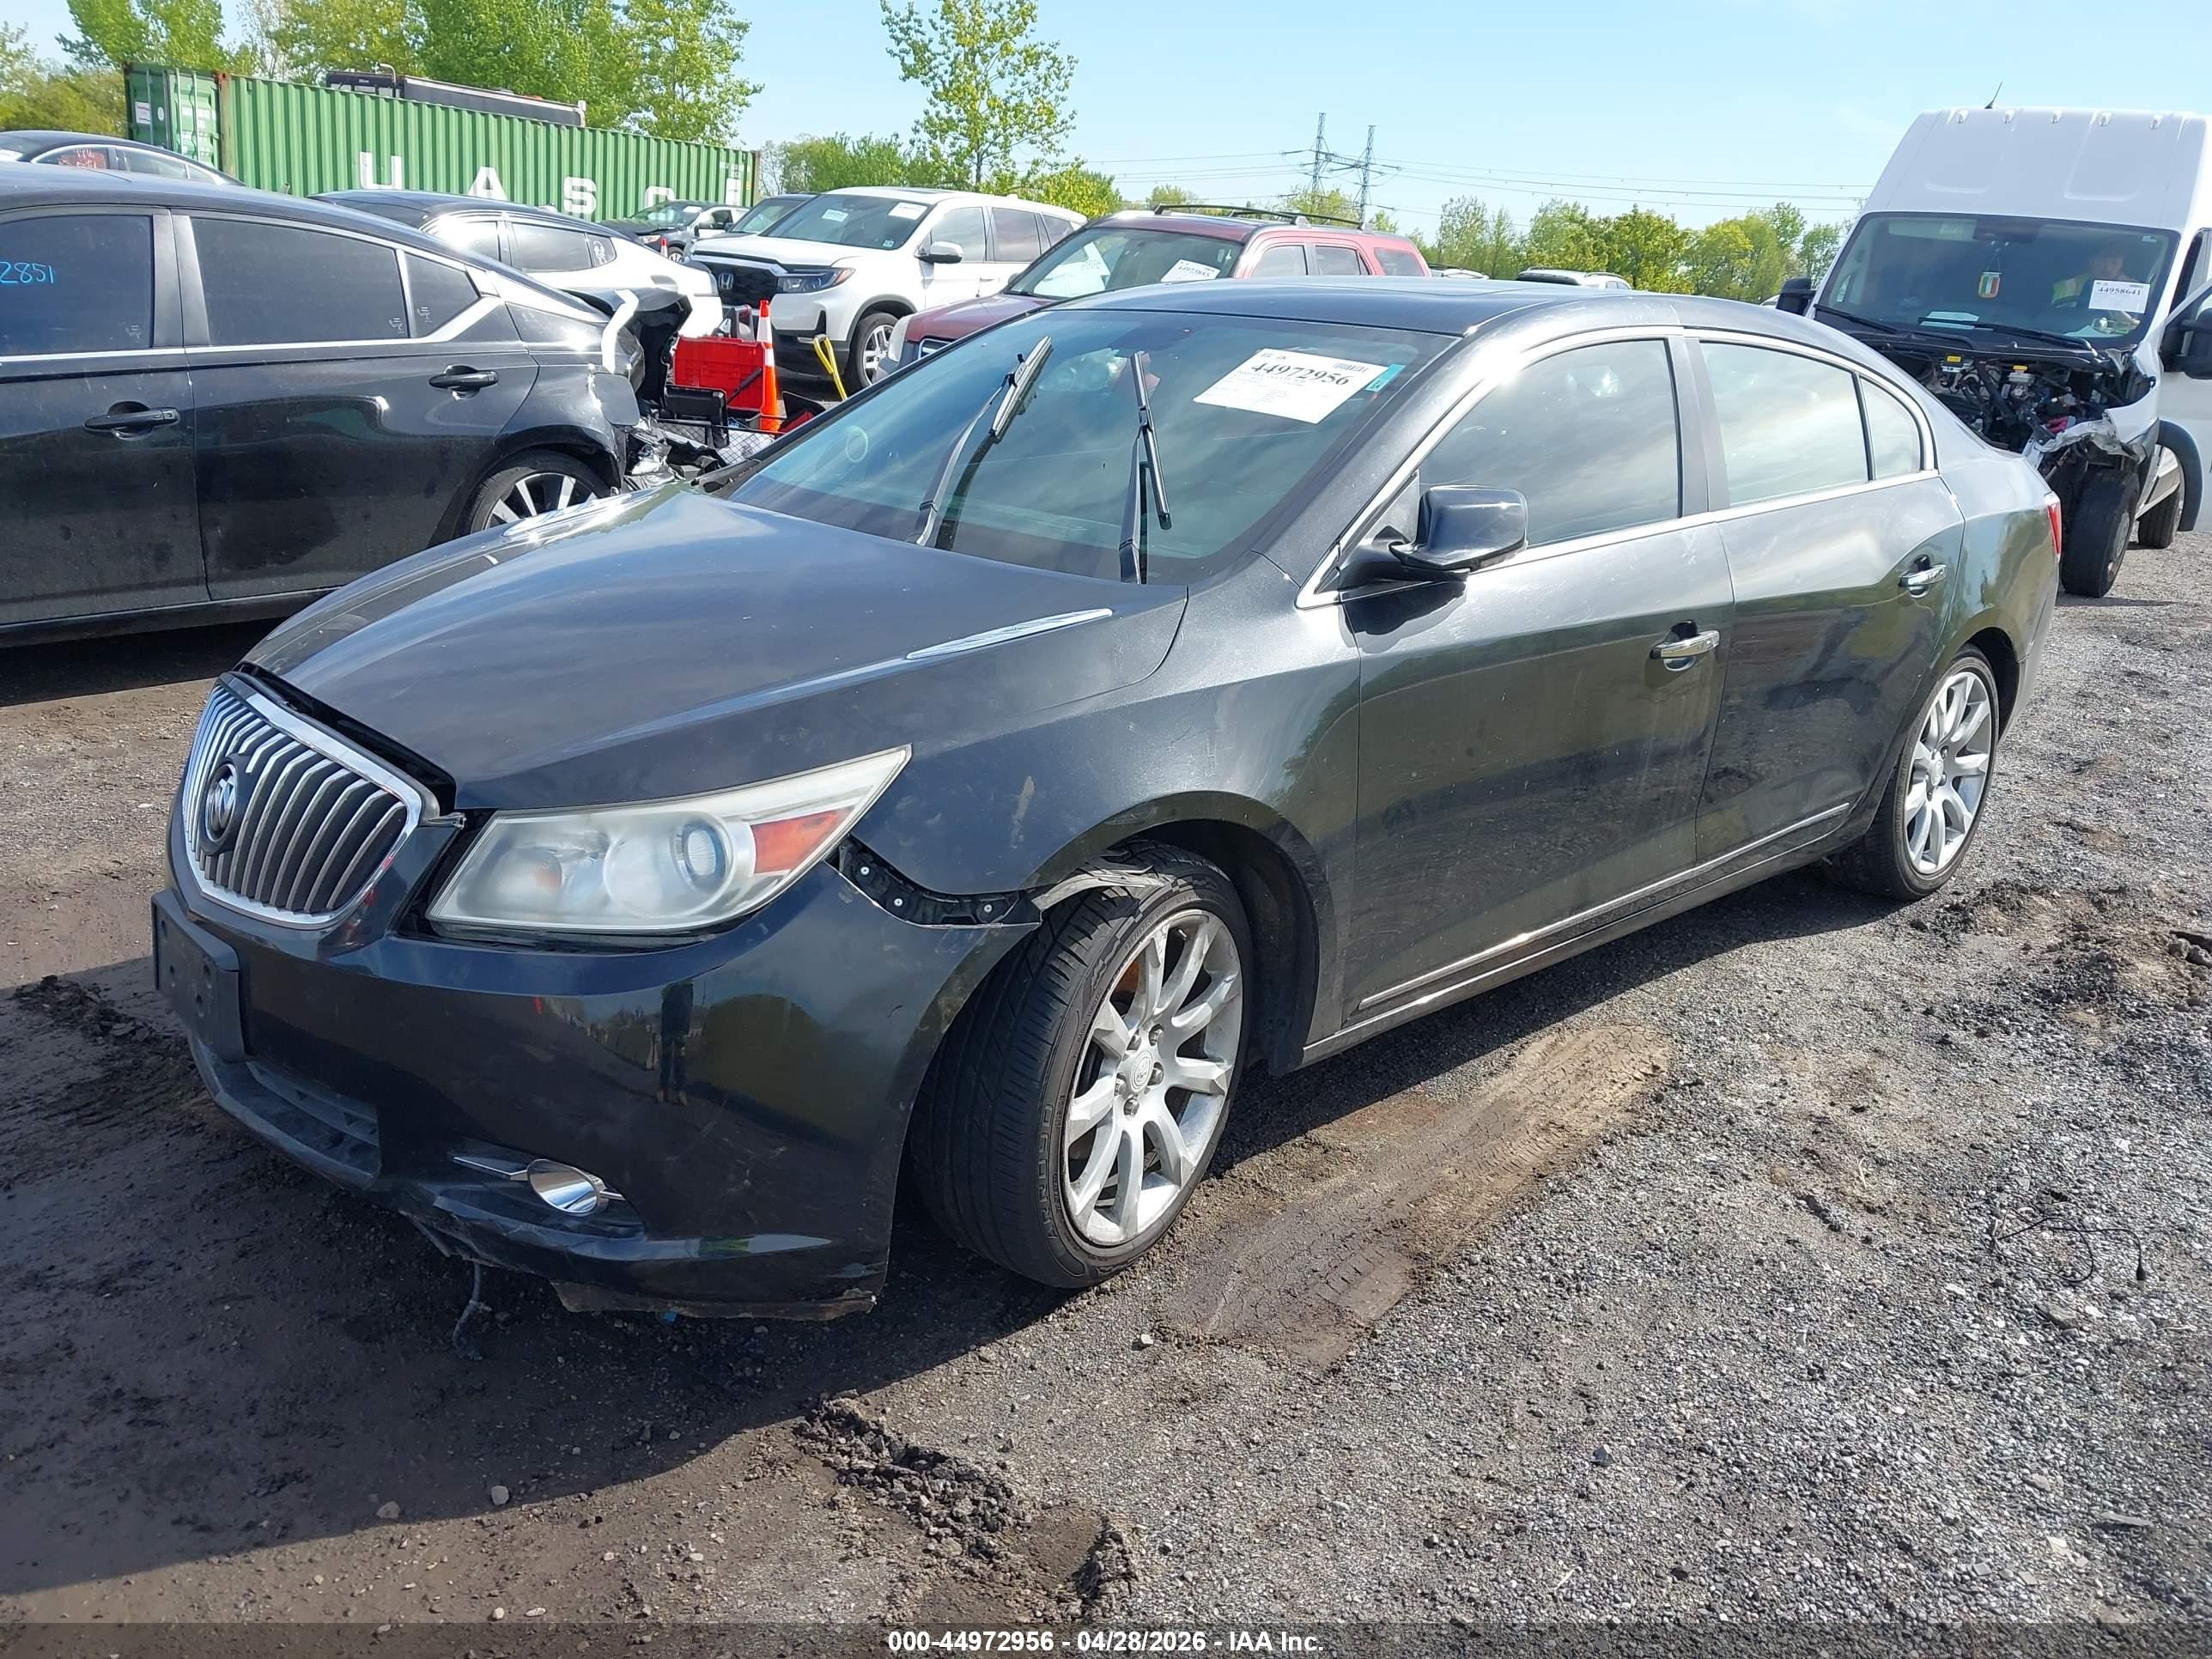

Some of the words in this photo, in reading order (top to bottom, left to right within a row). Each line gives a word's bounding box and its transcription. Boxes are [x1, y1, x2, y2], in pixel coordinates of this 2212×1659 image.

[0, 262, 55, 283] 2851
[2098, 286, 2142, 296] 44958641
[1251, 362, 1354, 386] 44972956
[1037, 1103, 1059, 1239] ARROYO
